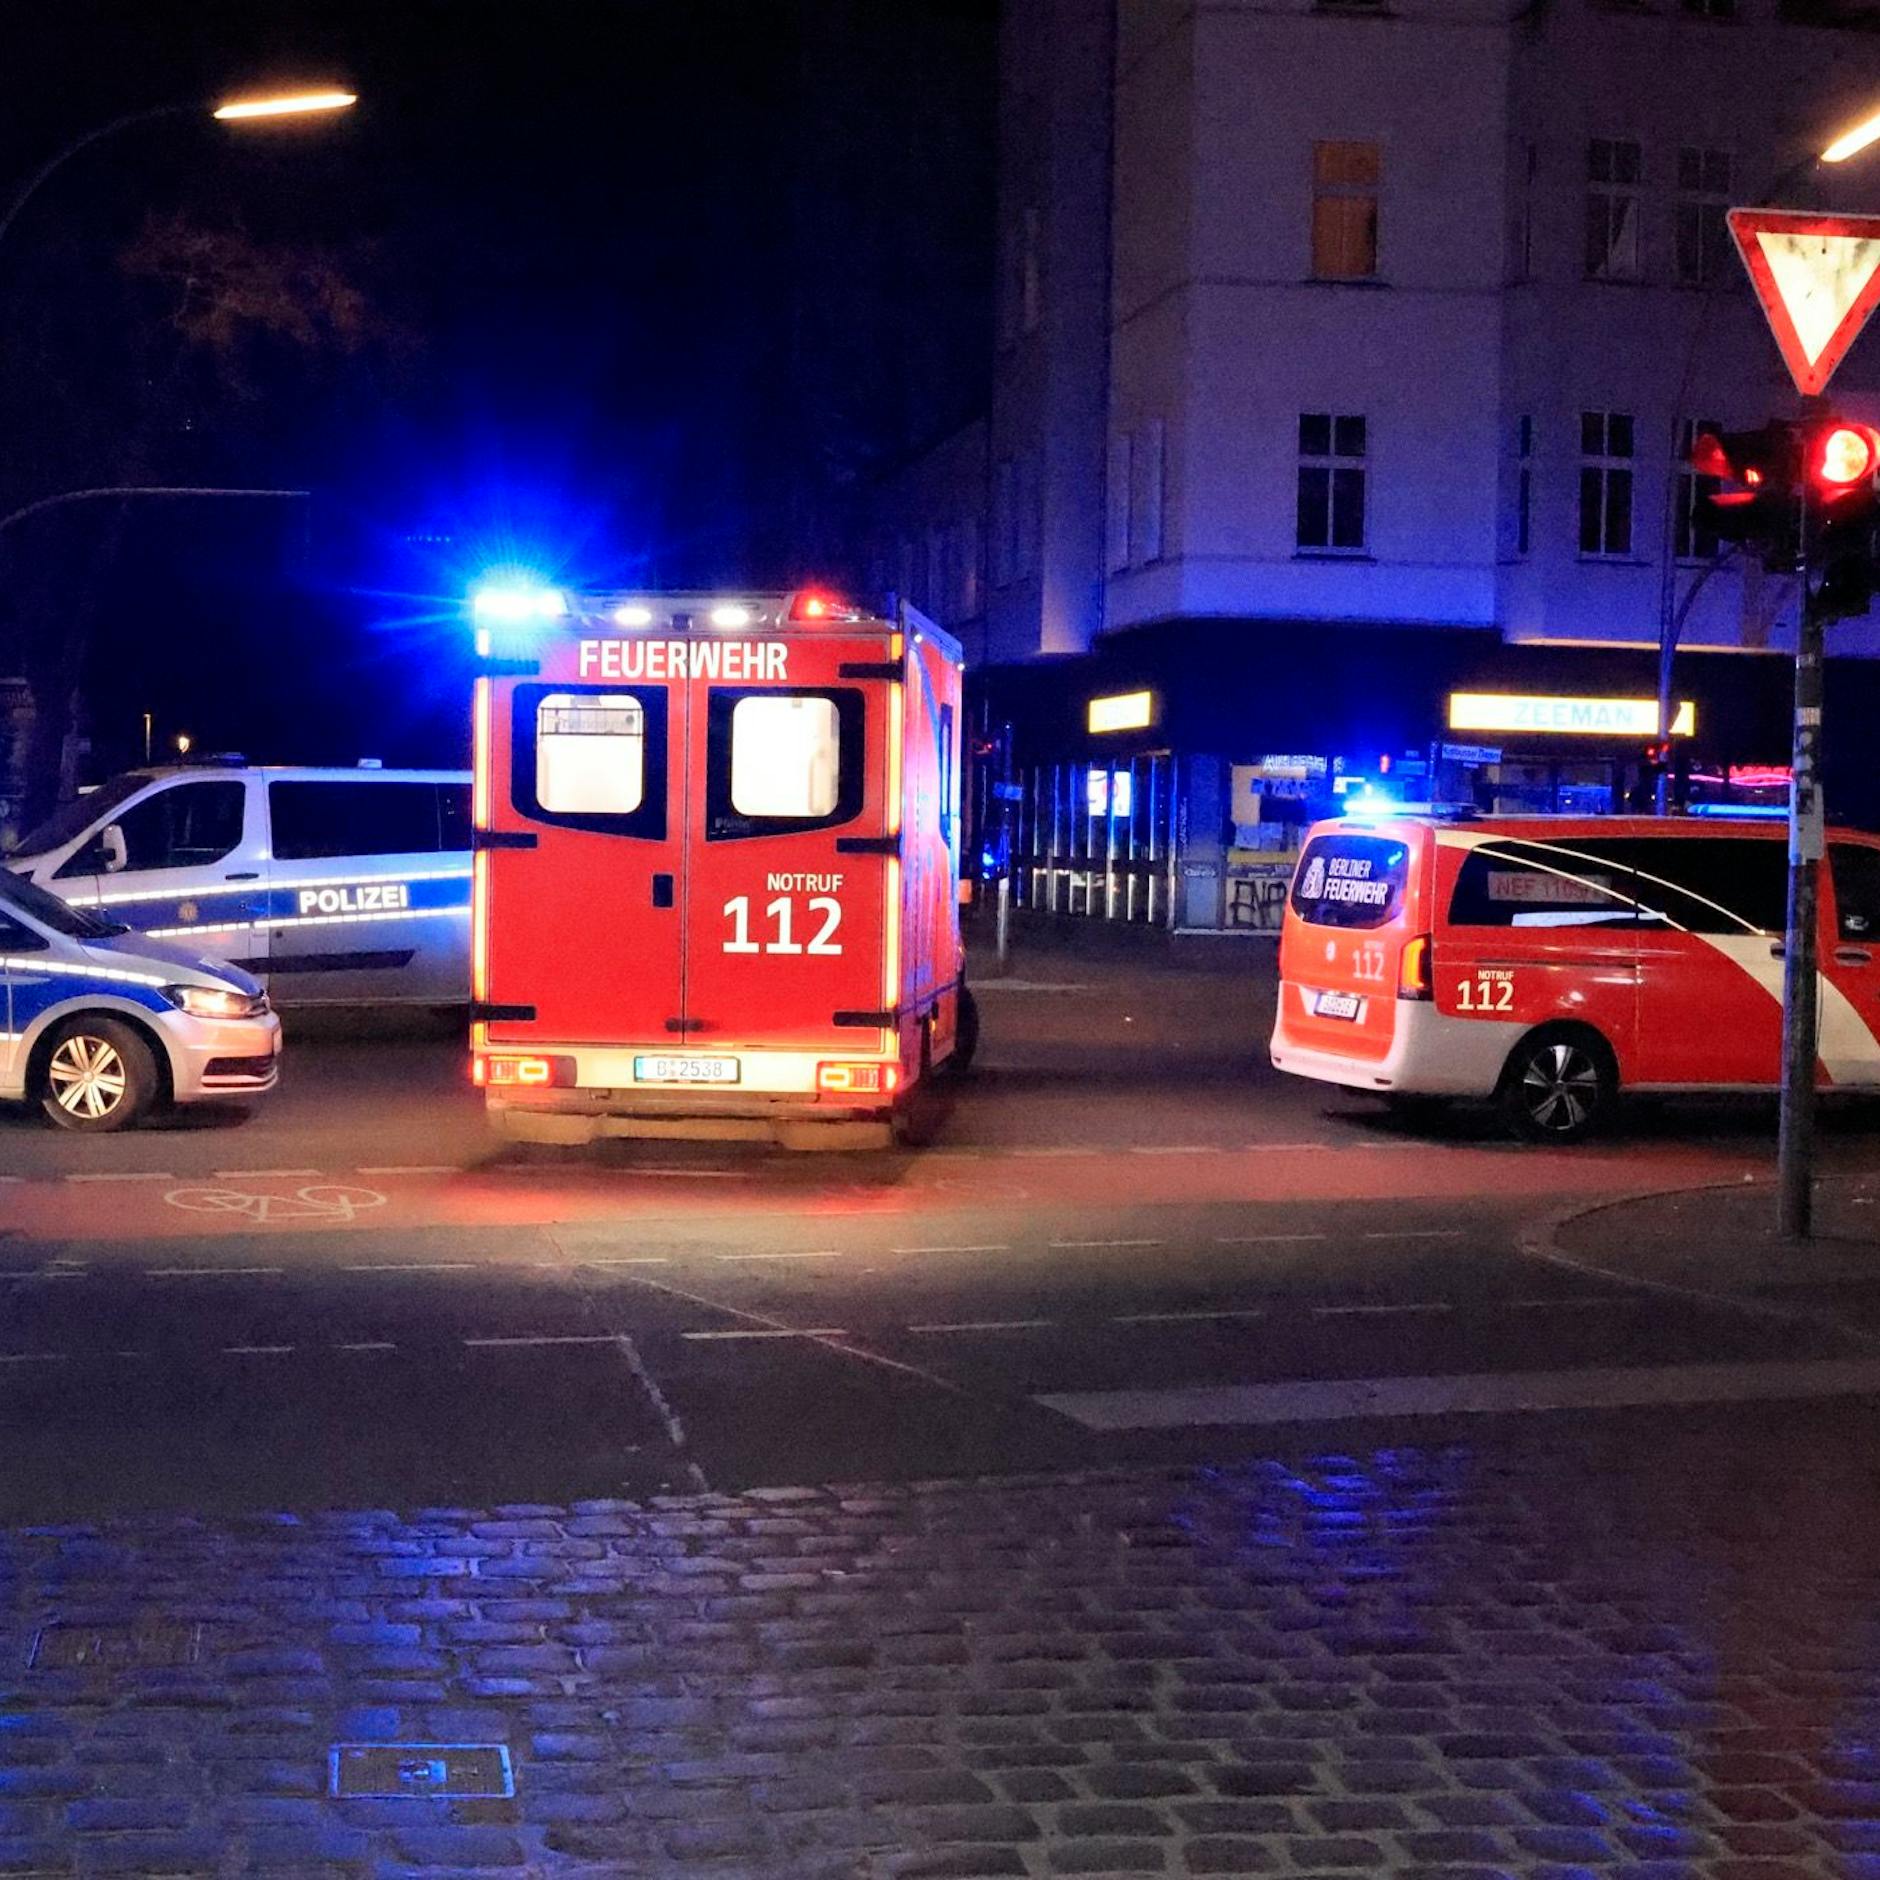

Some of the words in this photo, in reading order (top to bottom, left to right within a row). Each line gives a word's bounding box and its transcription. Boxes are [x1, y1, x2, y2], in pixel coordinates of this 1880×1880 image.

[579, 640, 788, 681] FEUERWEHR
[1513, 702, 1633, 727] ZEEMAN
[1328, 857, 1372, 878] BERLINER
[767, 873, 844, 893] NOTRUF
[1323, 879, 1389, 906] FEUERWEHR
[299, 885, 408, 914] POLIZEI
[722, 896, 844, 956] 112
[1352, 949, 1384, 981] 112
[1477, 970, 1515, 981] NOTRUF
[1456, 980, 1515, 1011] 112
[679, 1061, 723, 1077] 2538
